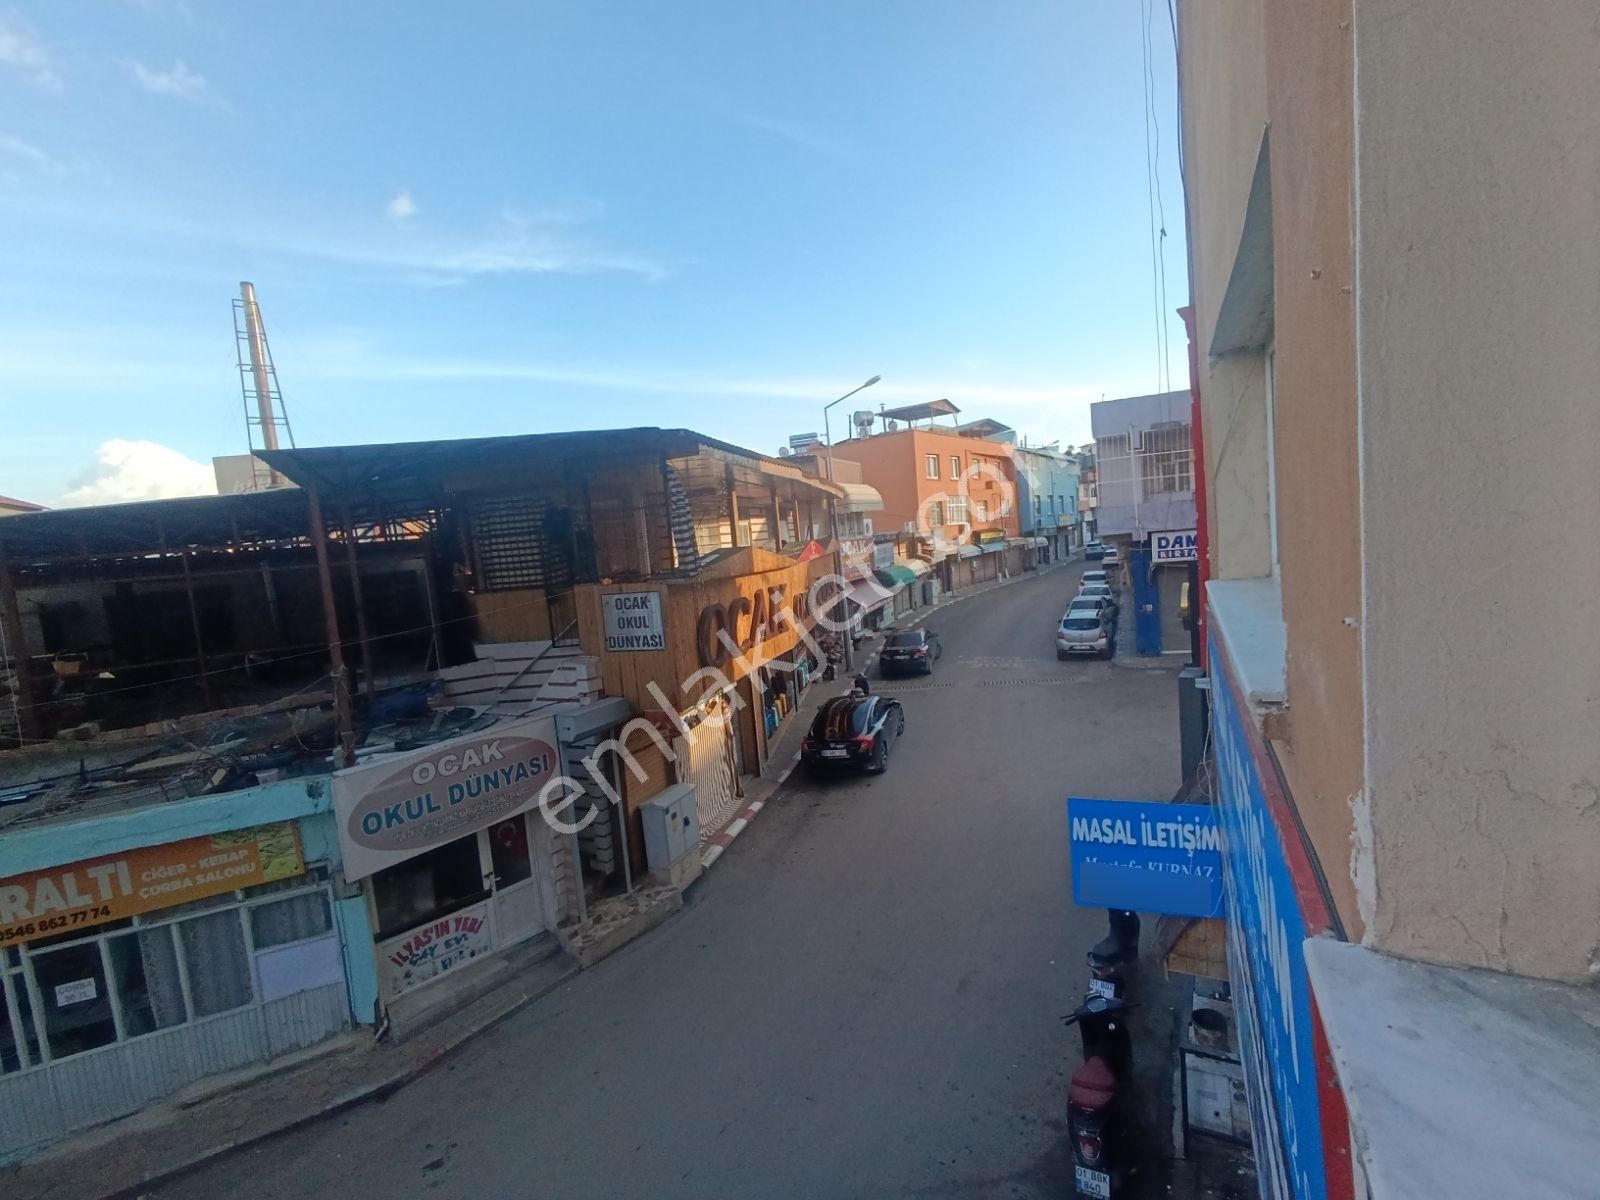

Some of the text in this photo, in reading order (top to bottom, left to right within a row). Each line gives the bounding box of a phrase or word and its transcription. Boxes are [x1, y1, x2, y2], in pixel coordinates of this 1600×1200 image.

[615, 597, 649, 610] OCAK
[618, 616, 650, 629] OKUL
[412, 739, 505, 785] OCAK
[361, 792, 441, 836] OKUL
[1073, 813, 1220, 857] MASAL İLETİŞİM
[199, 850, 249, 869] KEBAP
[196, 861, 257, 885] SALONU
[0, 861, 134, 926] RALTI
[70, 909, 88, 925] 77
[90, 905, 111, 920] 74
[1077, 1167, 1087, 1178] 01
[1083, 1180, 1101, 1193] 840
